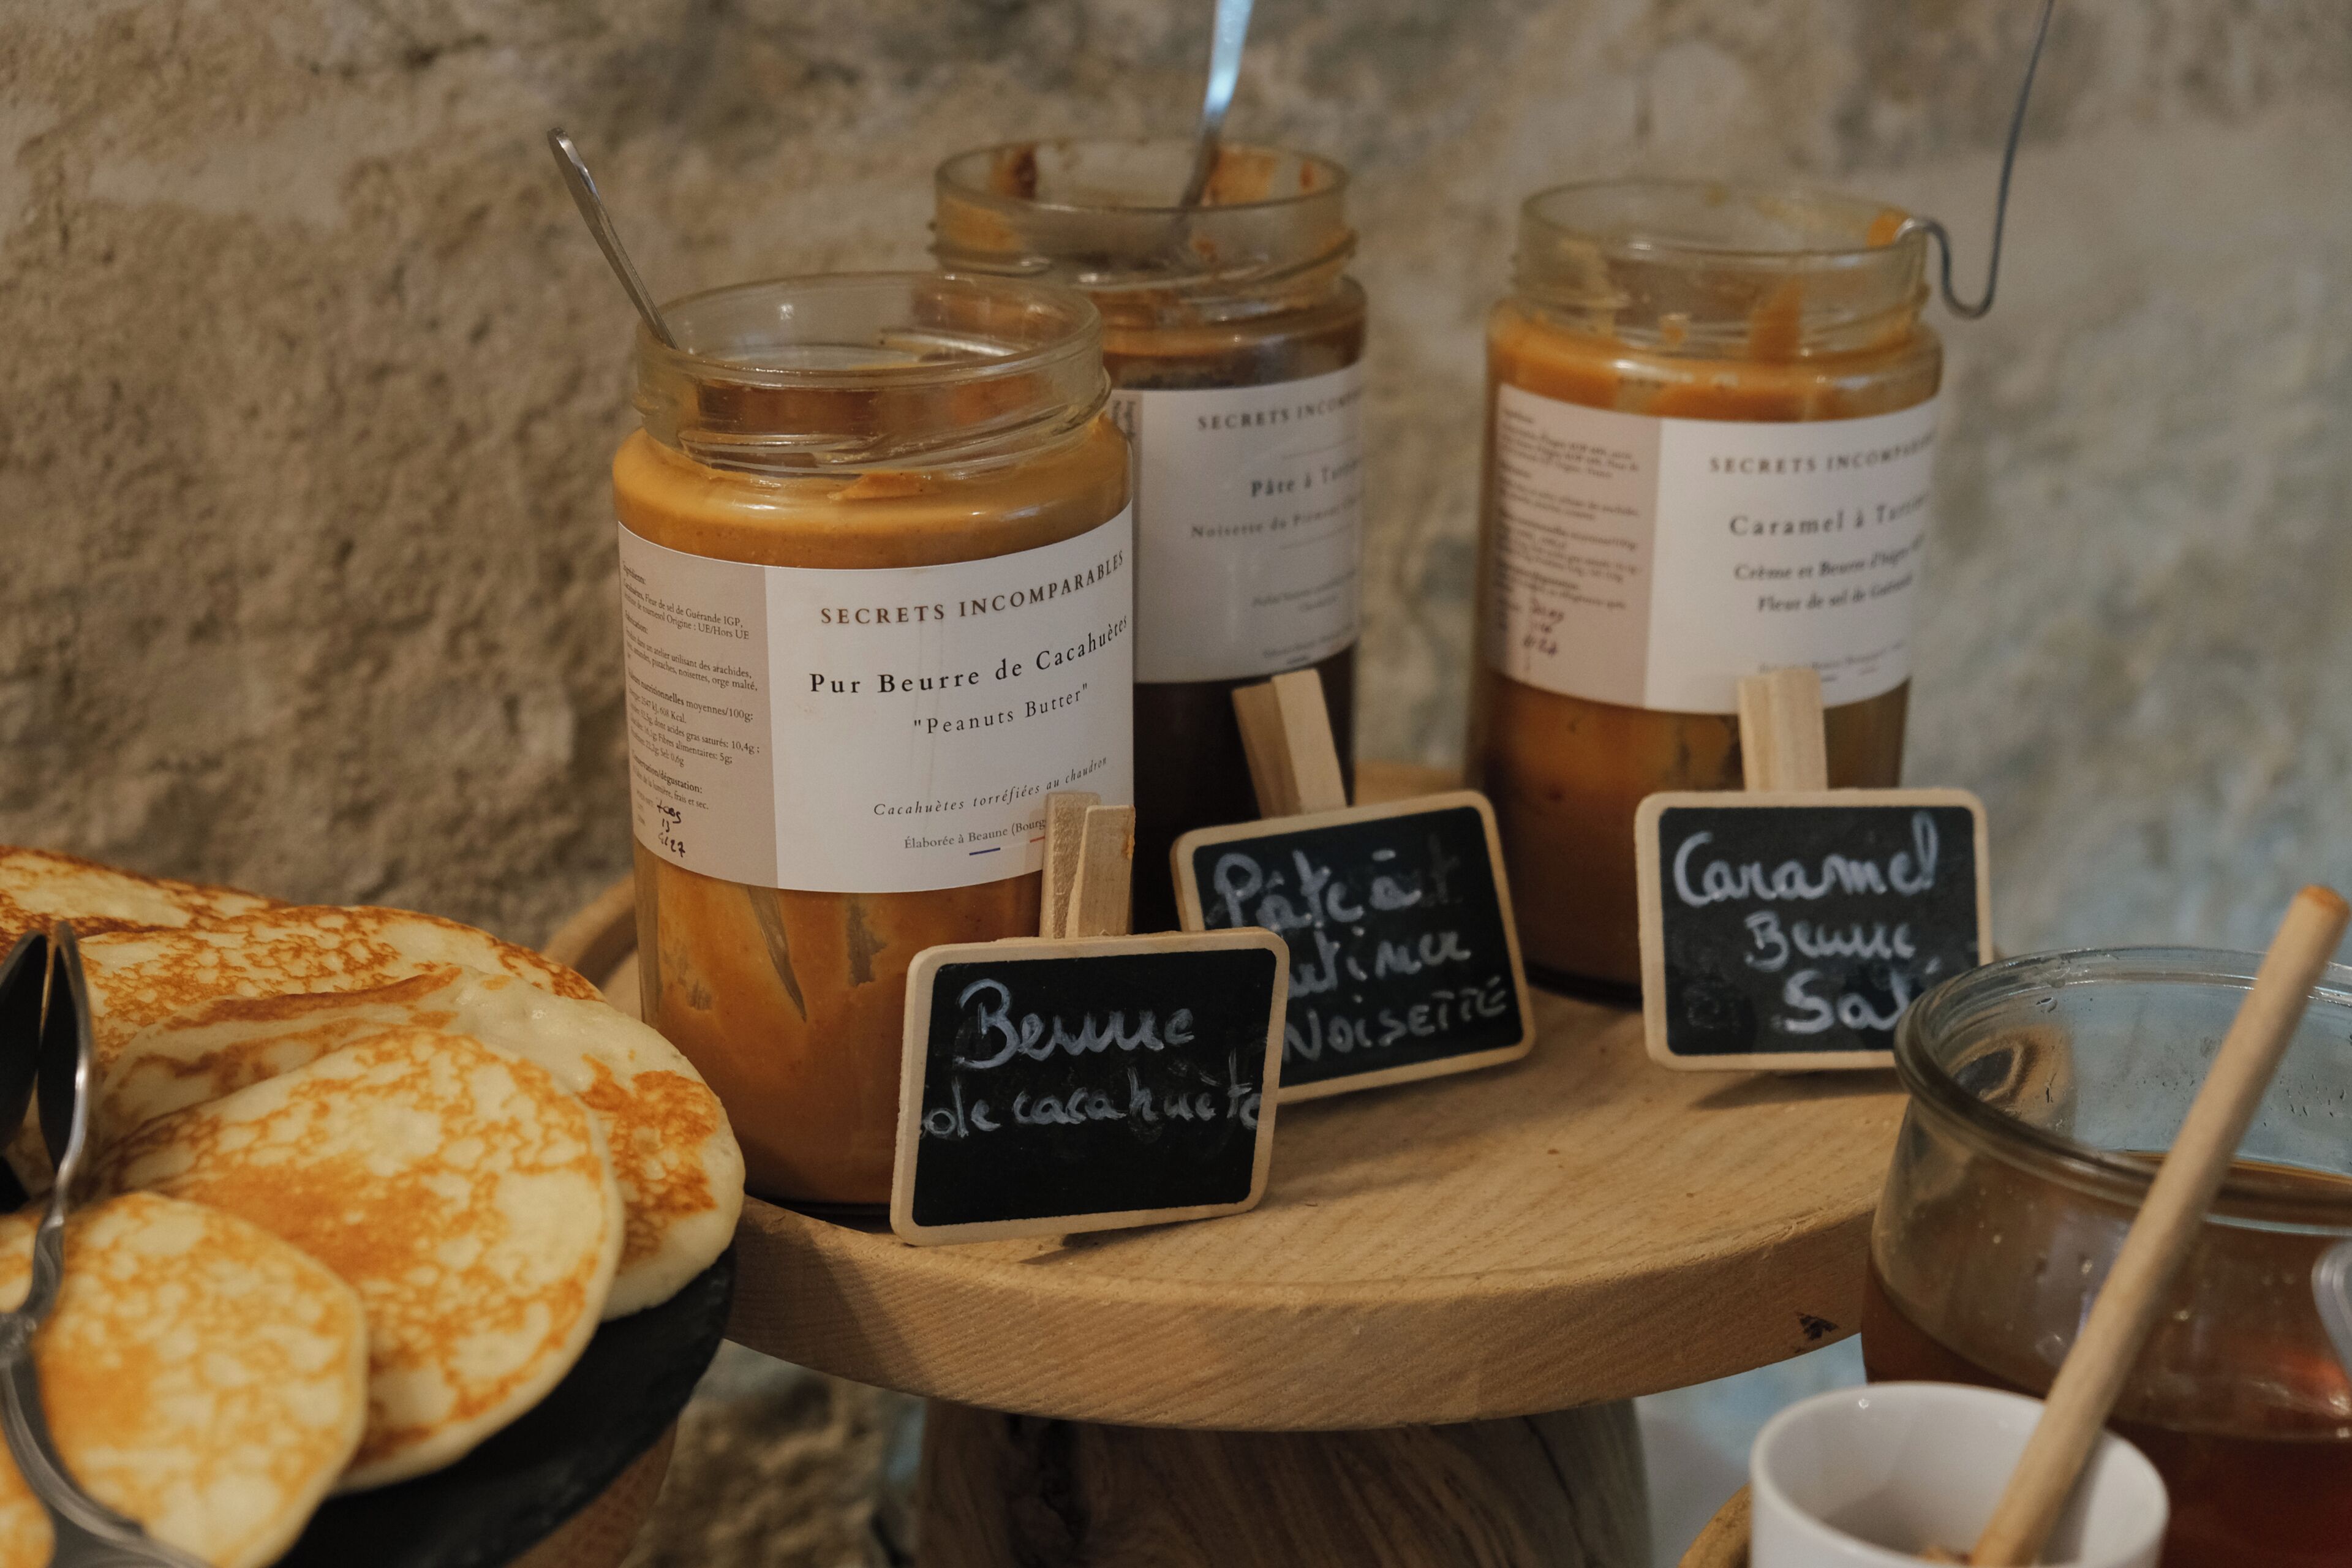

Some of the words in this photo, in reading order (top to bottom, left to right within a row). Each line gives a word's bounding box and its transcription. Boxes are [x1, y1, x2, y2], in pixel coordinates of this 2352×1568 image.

[1709, 457, 1817, 475] SECRETS
[1729, 510, 1844, 536] Caramel
[821, 604, 944, 624] SECRETS
[959, 551, 1123, 617] INCOMPARABLES
[666, 614, 692, 630] Origine
[698, 622, 733, 638] UE/Hors
[735, 629, 750, 639] UE
[676, 605, 684, 615] de
[685, 608, 722, 624] Guérande
[671, 654, 697, 668] utilisant
[699, 660, 710, 671] des
[712, 665, 752, 679] arachides,
[809, 673, 861, 693] Pur
[878, 671, 980, 693] Beurre
[995, 659, 1023, 680] de
[1036, 614, 1128, 670] Cacahuètes
[678, 669, 710, 684] noisettes,
[712, 677, 729, 689] orge
[732, 679, 758, 692] malté,
[641, 681, 685, 706] nutritionnelles
[686, 700, 753, 723] moyennes/100g:
[913, 709, 1014, 734] "Peanuts
[1025, 682, 1088, 718] Butter"
[675, 739, 718, 760] alimentaires:
[686, 732, 700, 742] gras
[702, 737, 729, 748] saturés:
[873, 798, 965, 816] Cacahuètes
[973, 785, 1040, 807] torréfiées
[1046, 778, 1060, 790] au
[1065, 756, 1107, 784] chaudron
[696, 800, 709, 810] sec.
[904, 835, 955, 849] Élaborée
[958, 834, 965, 843] à
[968, 827, 1009, 843] Beaune
[1011, 819, 1046, 836] (Bourg
[1674, 811, 1939, 908] Caramel
[921, 1076, 1001, 1139] de
